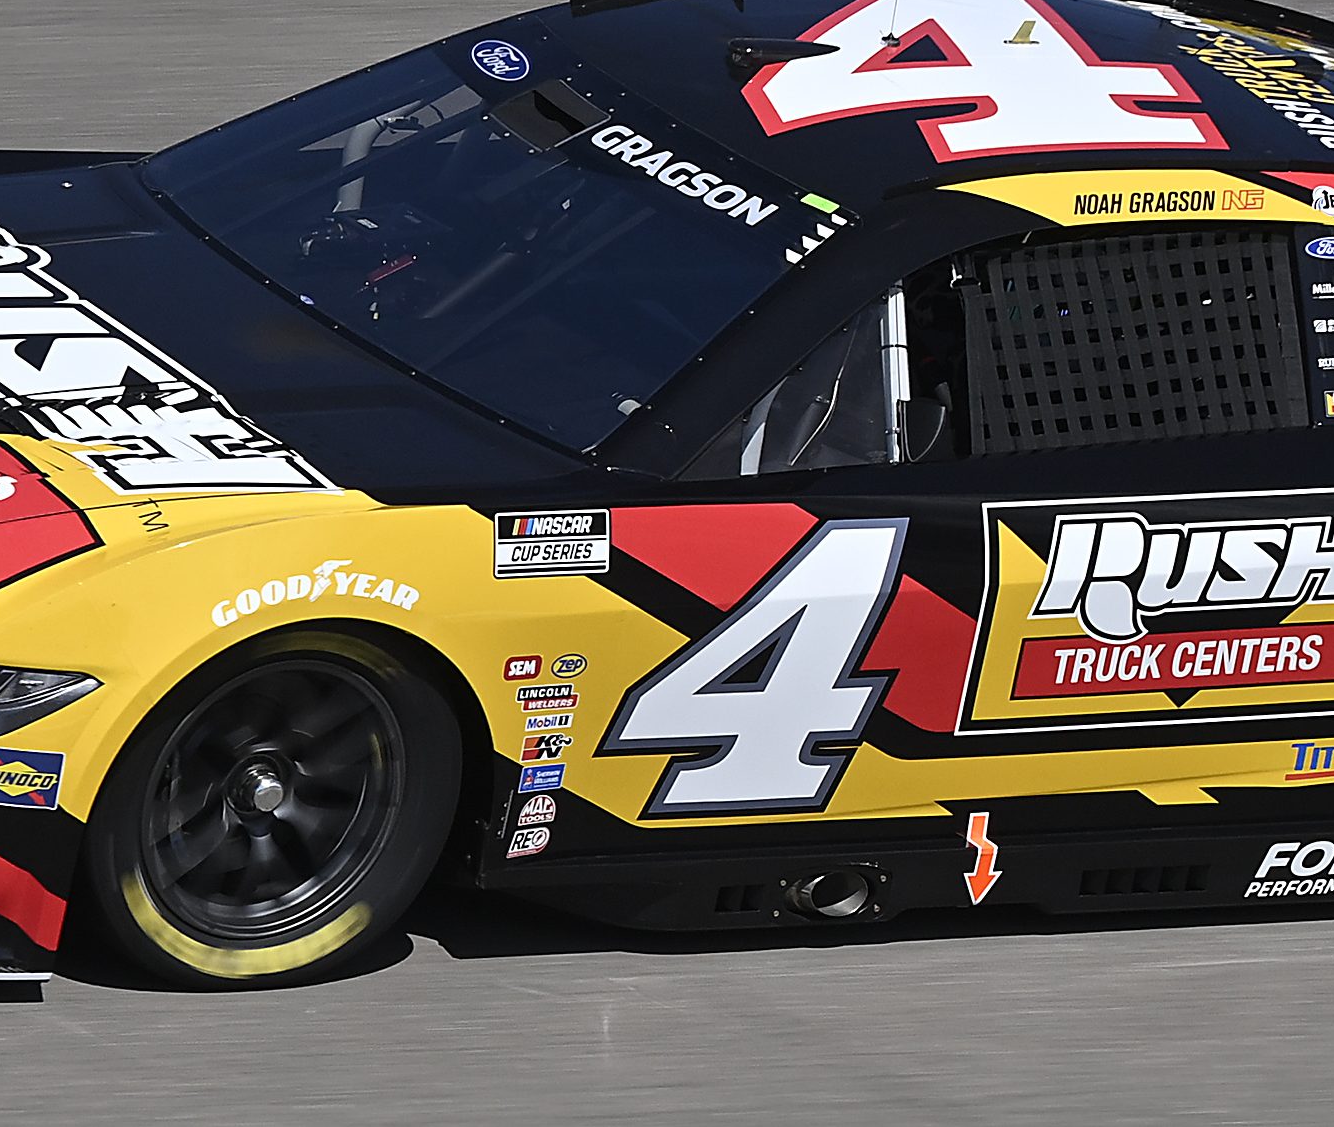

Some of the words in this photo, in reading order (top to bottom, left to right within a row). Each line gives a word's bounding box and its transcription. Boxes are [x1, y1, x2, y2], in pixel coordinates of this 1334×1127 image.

[476, 46, 520, 75] Ford
[590, 125, 780, 226] GRAGSON
[1073, 192, 1123, 215] NOAH
[1129, 189, 1216, 214] GRAGSON
[531, 515, 593, 535] NASCAR
[511, 545, 541, 562] CUP
[542, 543, 594, 560] SERIES
[508, 659, 537, 677] SEM
[591, 517, 910, 820] 4
[1054, 643, 1167, 685] TRUCK
[1171, 634, 1323, 678] CENTERS
[519, 687, 570, 700] LINCOLN
[528, 699, 574, 710] WELDERS
[527, 716, 558, 730] Mobil
[521, 796, 553, 817] MAC
[520, 813, 554, 824] TOOLS
